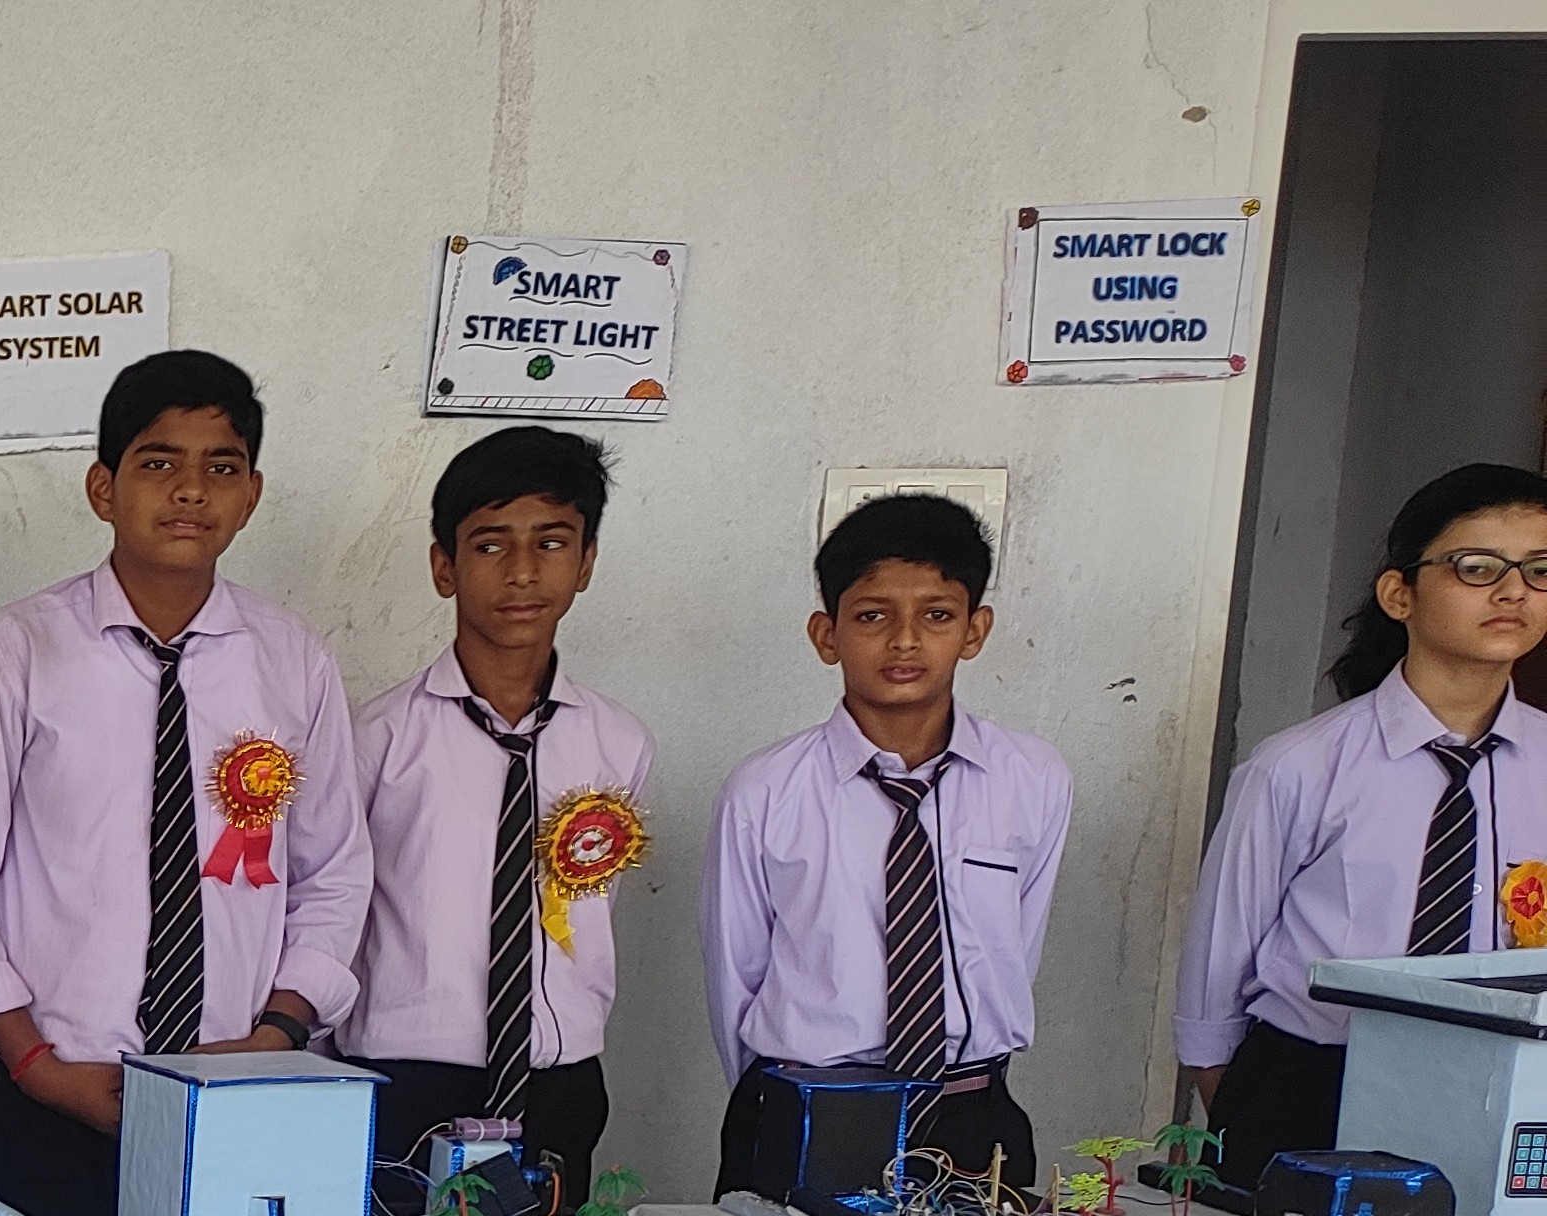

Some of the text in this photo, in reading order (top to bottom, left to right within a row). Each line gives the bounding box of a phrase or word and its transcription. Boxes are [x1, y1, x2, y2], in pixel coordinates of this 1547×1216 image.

[1052, 231, 1228, 259] SMART LOCK
[513, 270, 621, 301] SMART
[1093, 276, 1179, 302] USING
[57, 291, 144, 317] SOLAR
[462, 314, 660, 350] STREET LIGHT
[1054, 318, 1208, 344] PASSWORD
